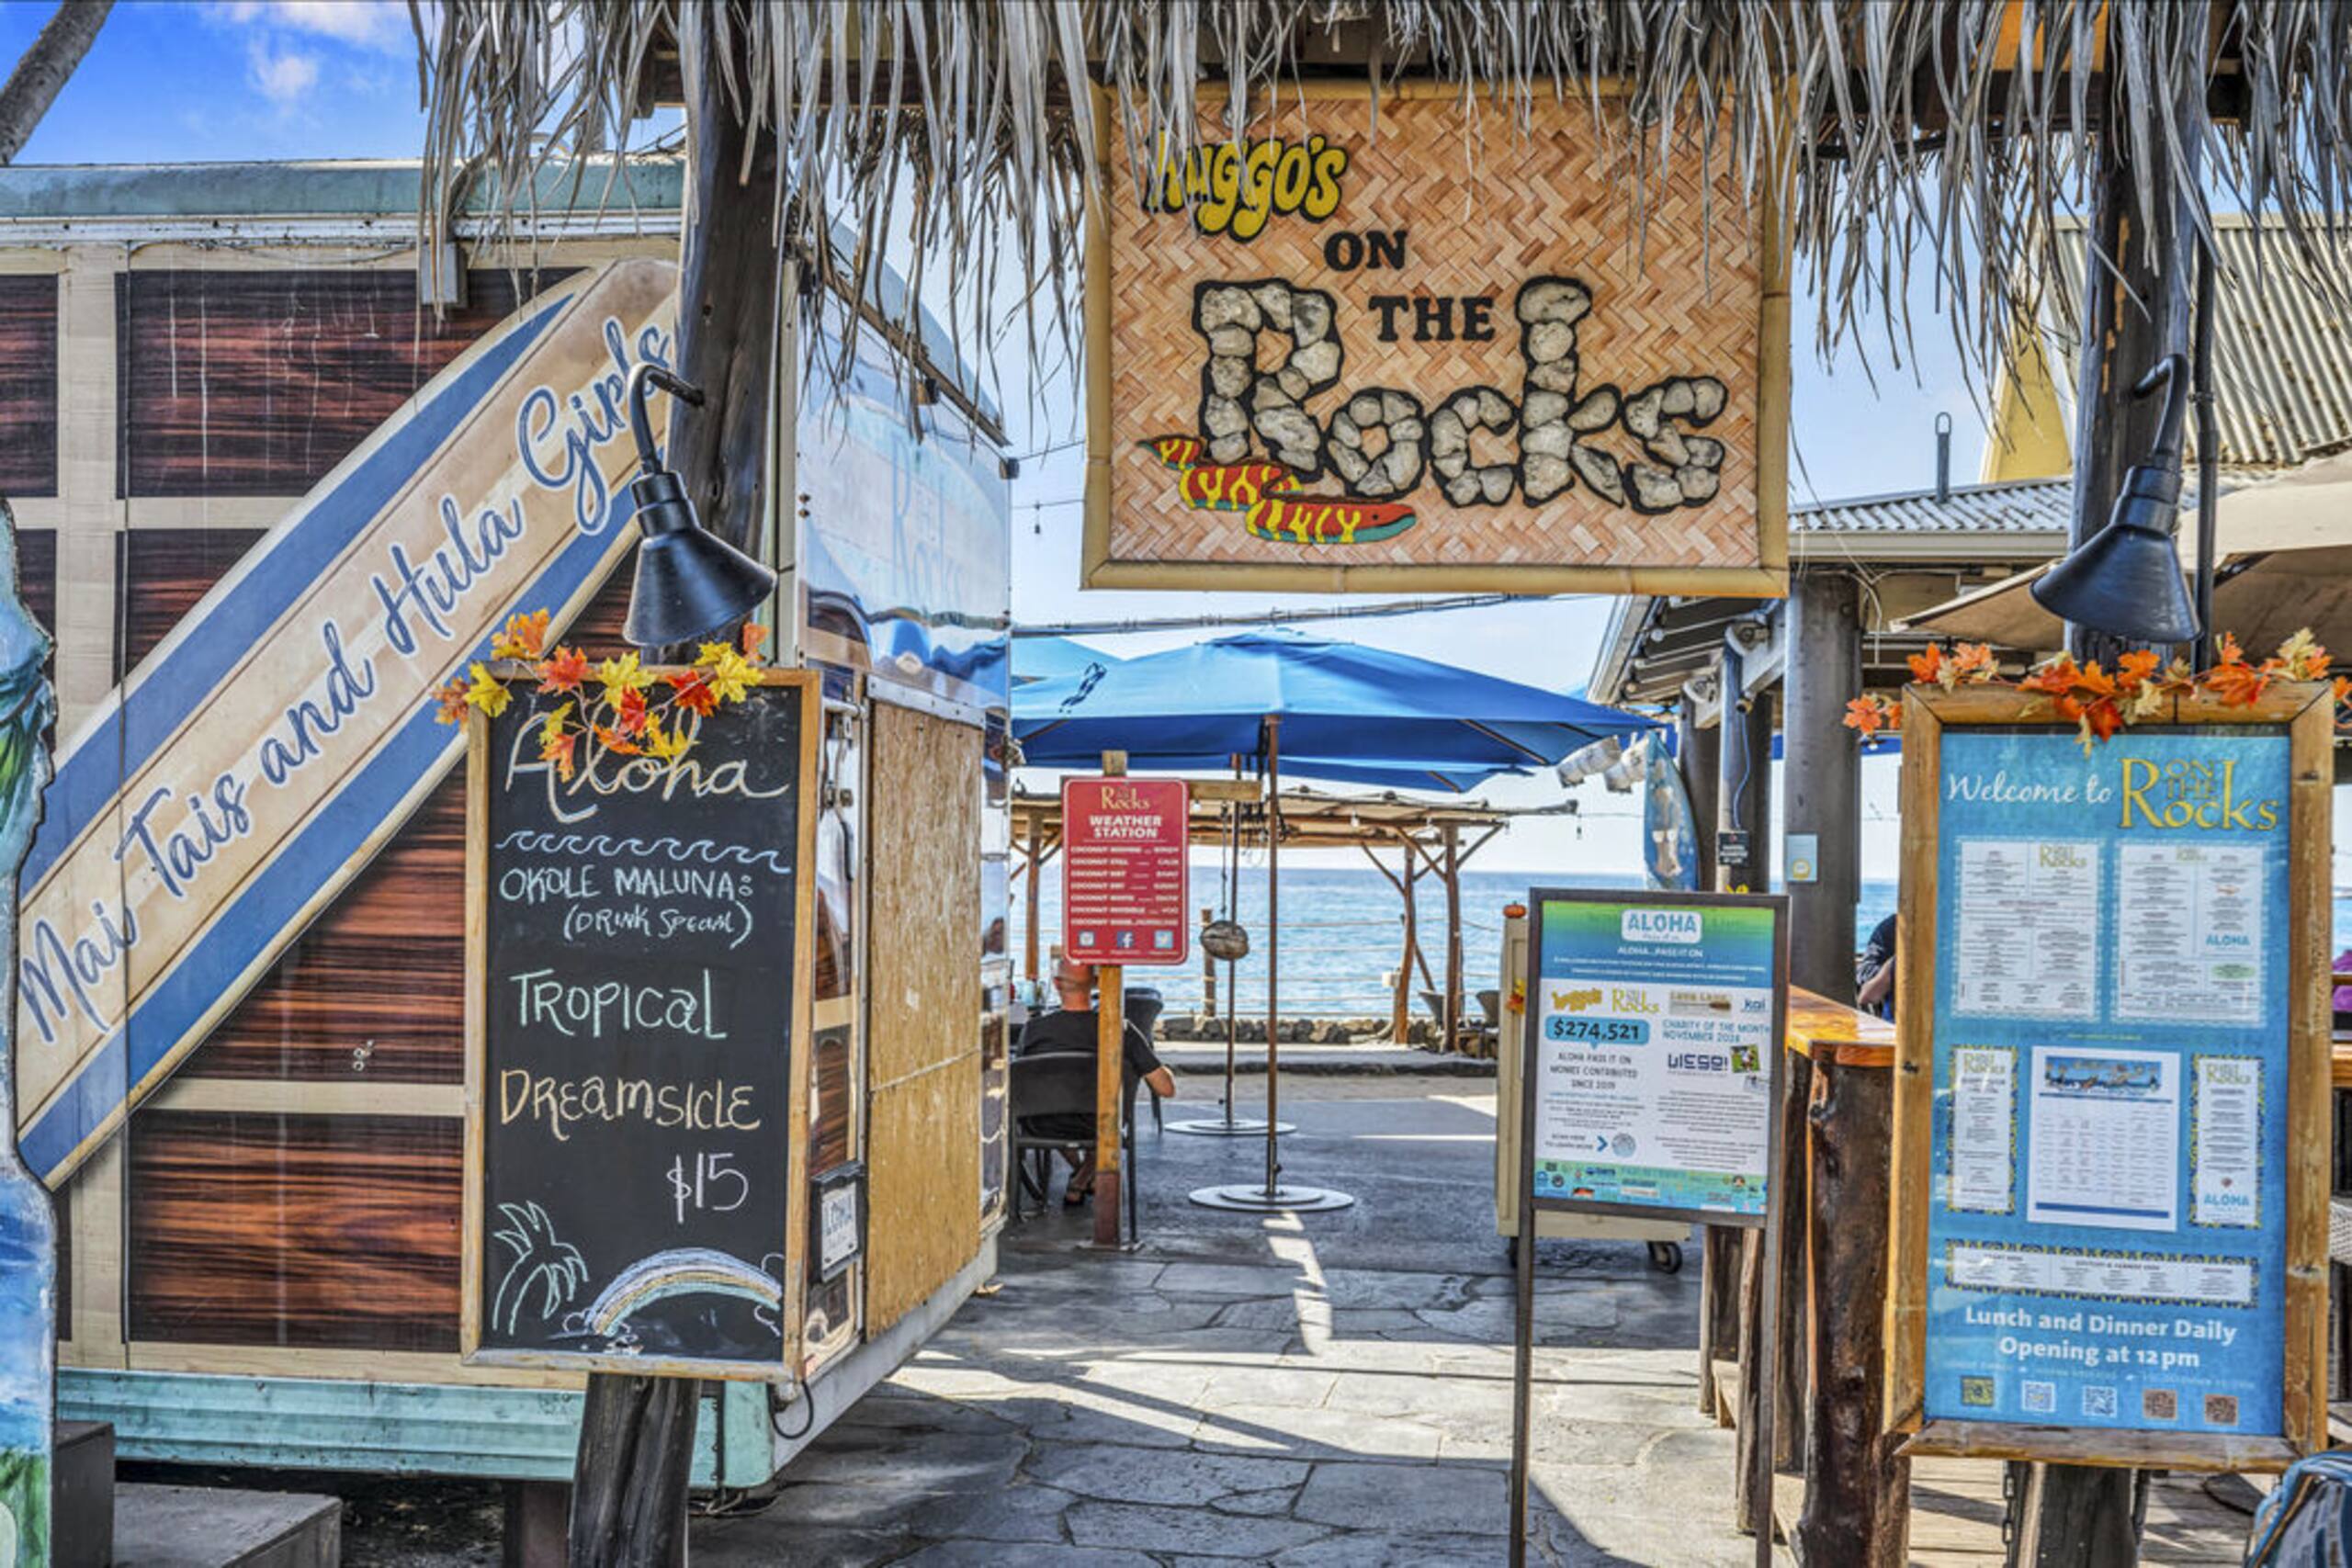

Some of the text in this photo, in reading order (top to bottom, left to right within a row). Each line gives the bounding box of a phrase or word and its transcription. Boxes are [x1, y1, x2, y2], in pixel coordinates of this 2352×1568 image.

[1324, 231, 1408, 271] ON
[1368, 295, 1495, 343] THE
[1193, 276, 1730, 514] Rocks
[19, 900, 137, 1043] Mai
[114, 773, 251, 897] Tais
[261, 621, 375, 784] and
[373, 497, 523, 655] Hula
[505, 698, 790, 824] Aloha
[2165, 759, 2215, 779] ON
[1101, 785, 1151, 809] Rocks
[1948, 769, 2112, 804] Welcome to
[2120, 758, 2279, 830] Rocks
[1089, 815, 1162, 827] WEATHER
[1094, 828, 1158, 840] STATION
[499, 864, 601, 904] OKOLE
[1628, 912, 1697, 933] ALOHA
[1689, 949, 1703, 957] ON
[2206, 935, 2250, 946] ALOHA
[1554, 1017, 1639, 1041] $274,521
[1662, 1019, 1700, 1030] CHARITY
[1719, 1021, 1735, 1032] THE
[1662, 1030, 1713, 1041] NOVEMBER
[666, 1152, 750, 1224] $15
[1965, 1305, 2238, 1347] Lunch and Dinner Daily
[1999, 1336, 2100, 1366] Opening
[2105, 1346, 2131, 1364] at
